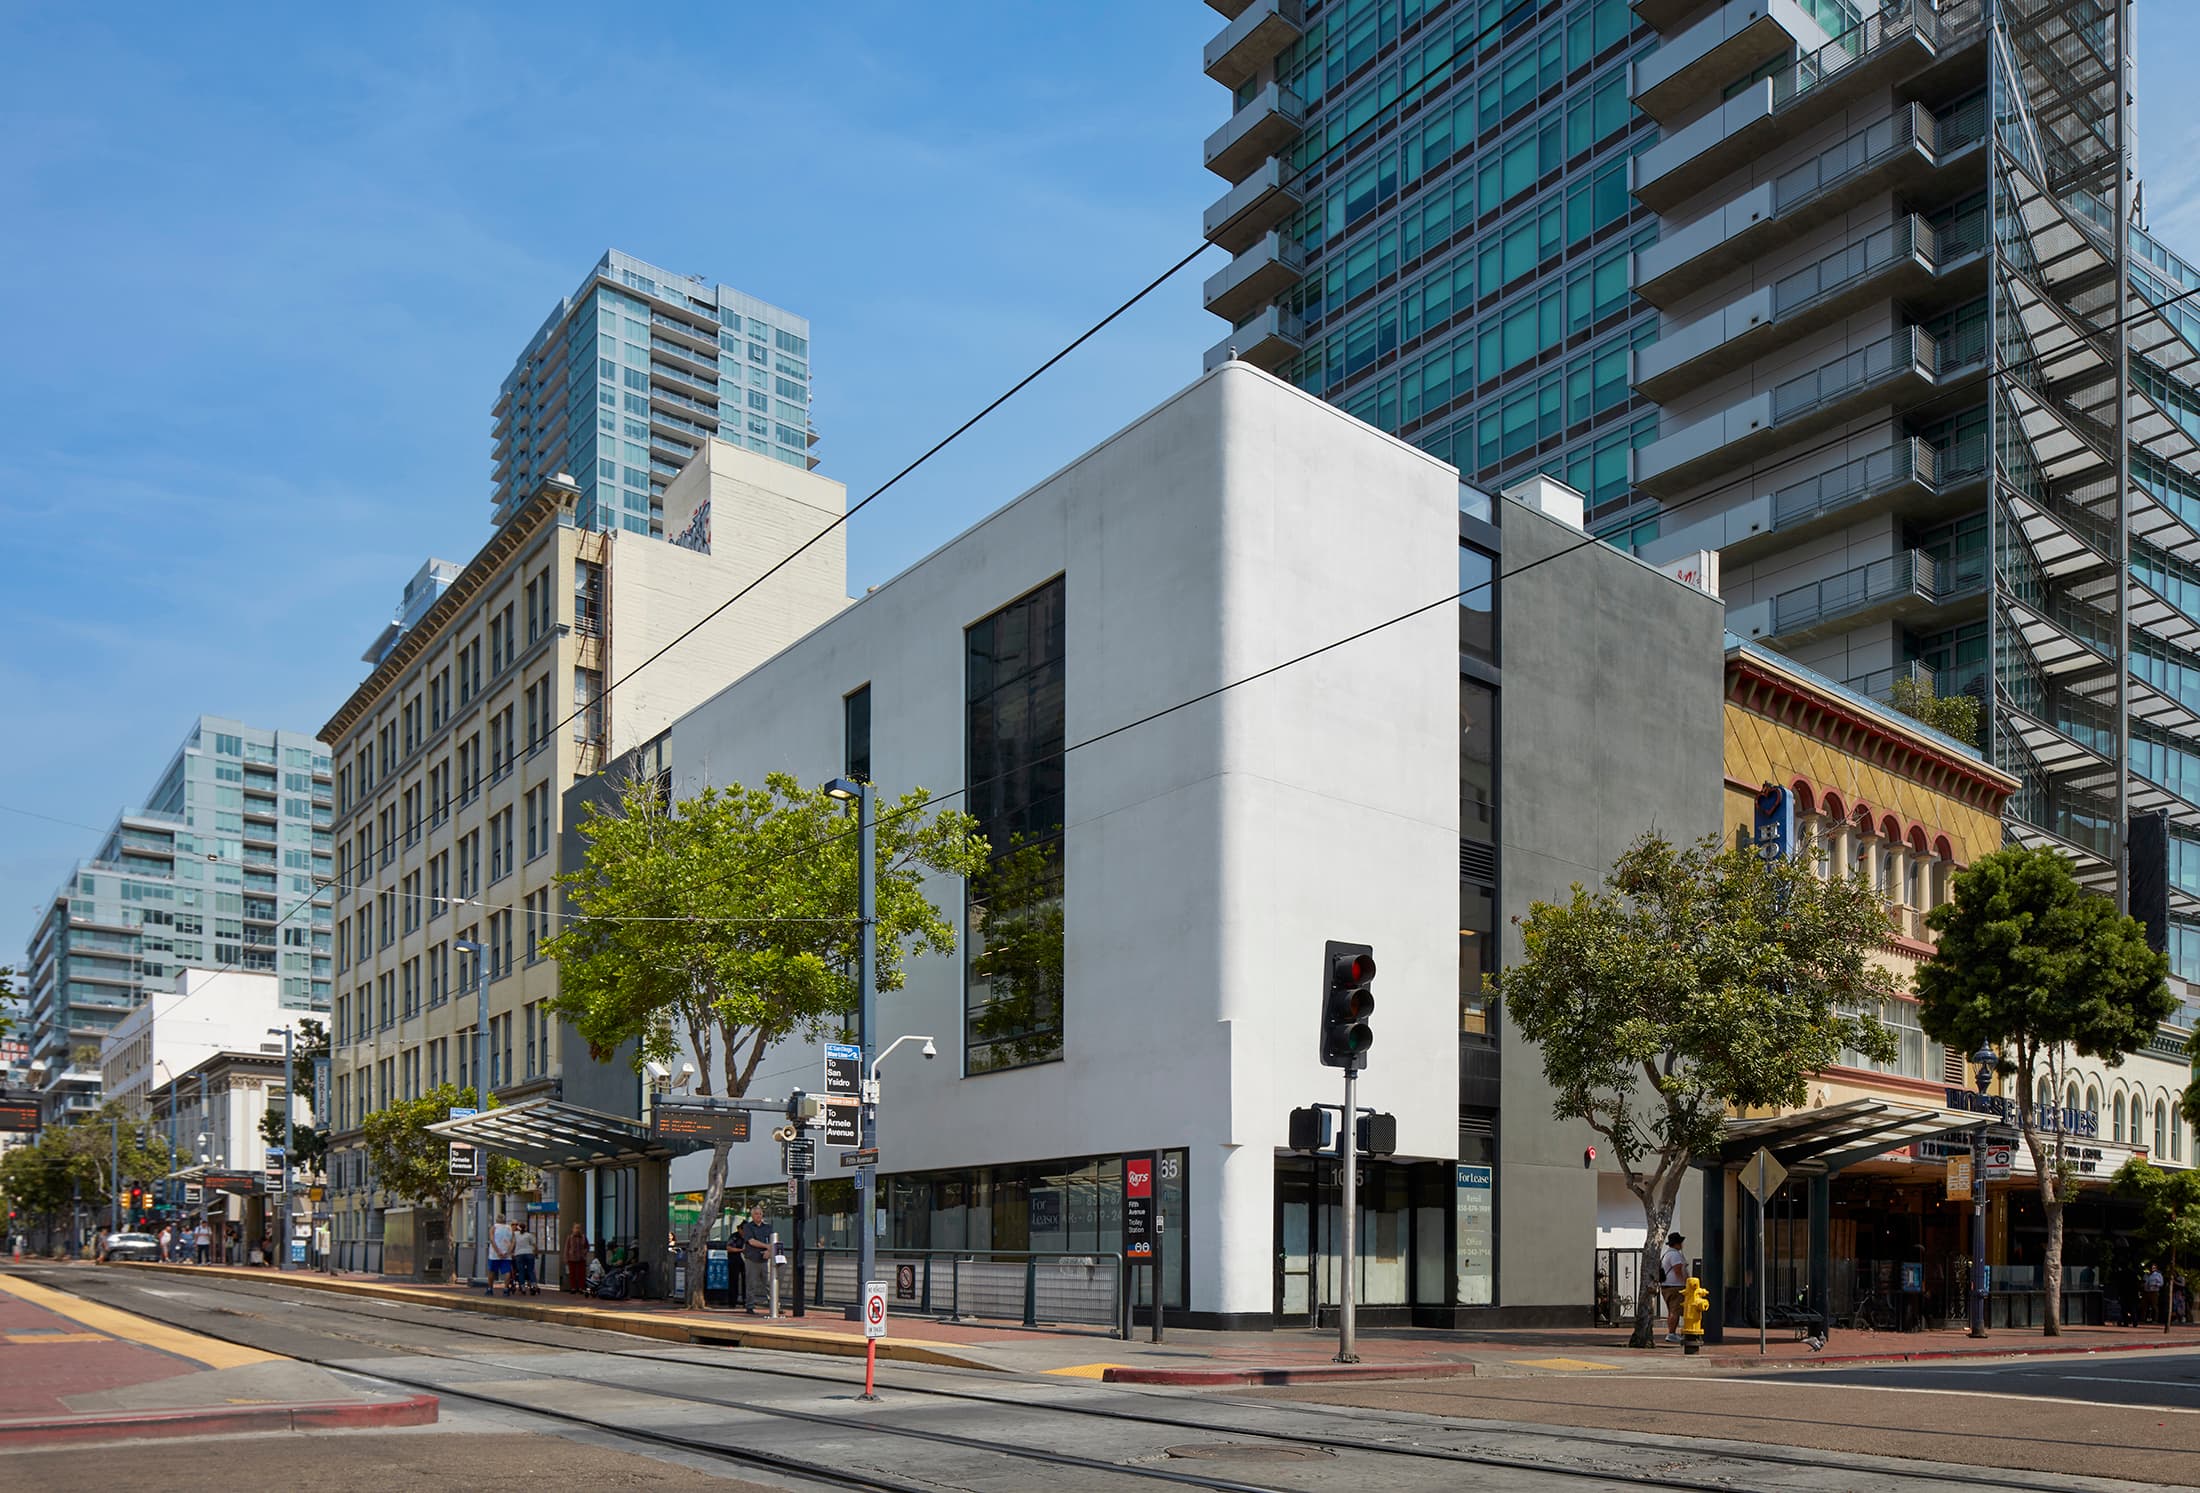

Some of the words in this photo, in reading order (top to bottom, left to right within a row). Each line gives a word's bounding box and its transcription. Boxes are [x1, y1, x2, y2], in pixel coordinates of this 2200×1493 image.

[827, 1068, 842, 1077] San
[827, 1077, 850, 1087] Ysidro
[828, 1109, 836, 1117] To
[1945, 1088, 2016, 1126] HOSE
[2040, 1103, 2098, 1138] BUES
[827, 1119, 851, 1128] Arnele
[827, 1128, 855, 1137] Avenue
[1161, 1159, 1178, 1178] 65
[1129, 1171, 1149, 1186] MTS
[1331, 1168, 1364, 1187] 105
[1459, 1171, 1470, 1182] For
[1470, 1172, 1489, 1184] Lease
[1032, 1198, 1046, 1210] For
[1128, 1208, 1146, 1216] Avenue
